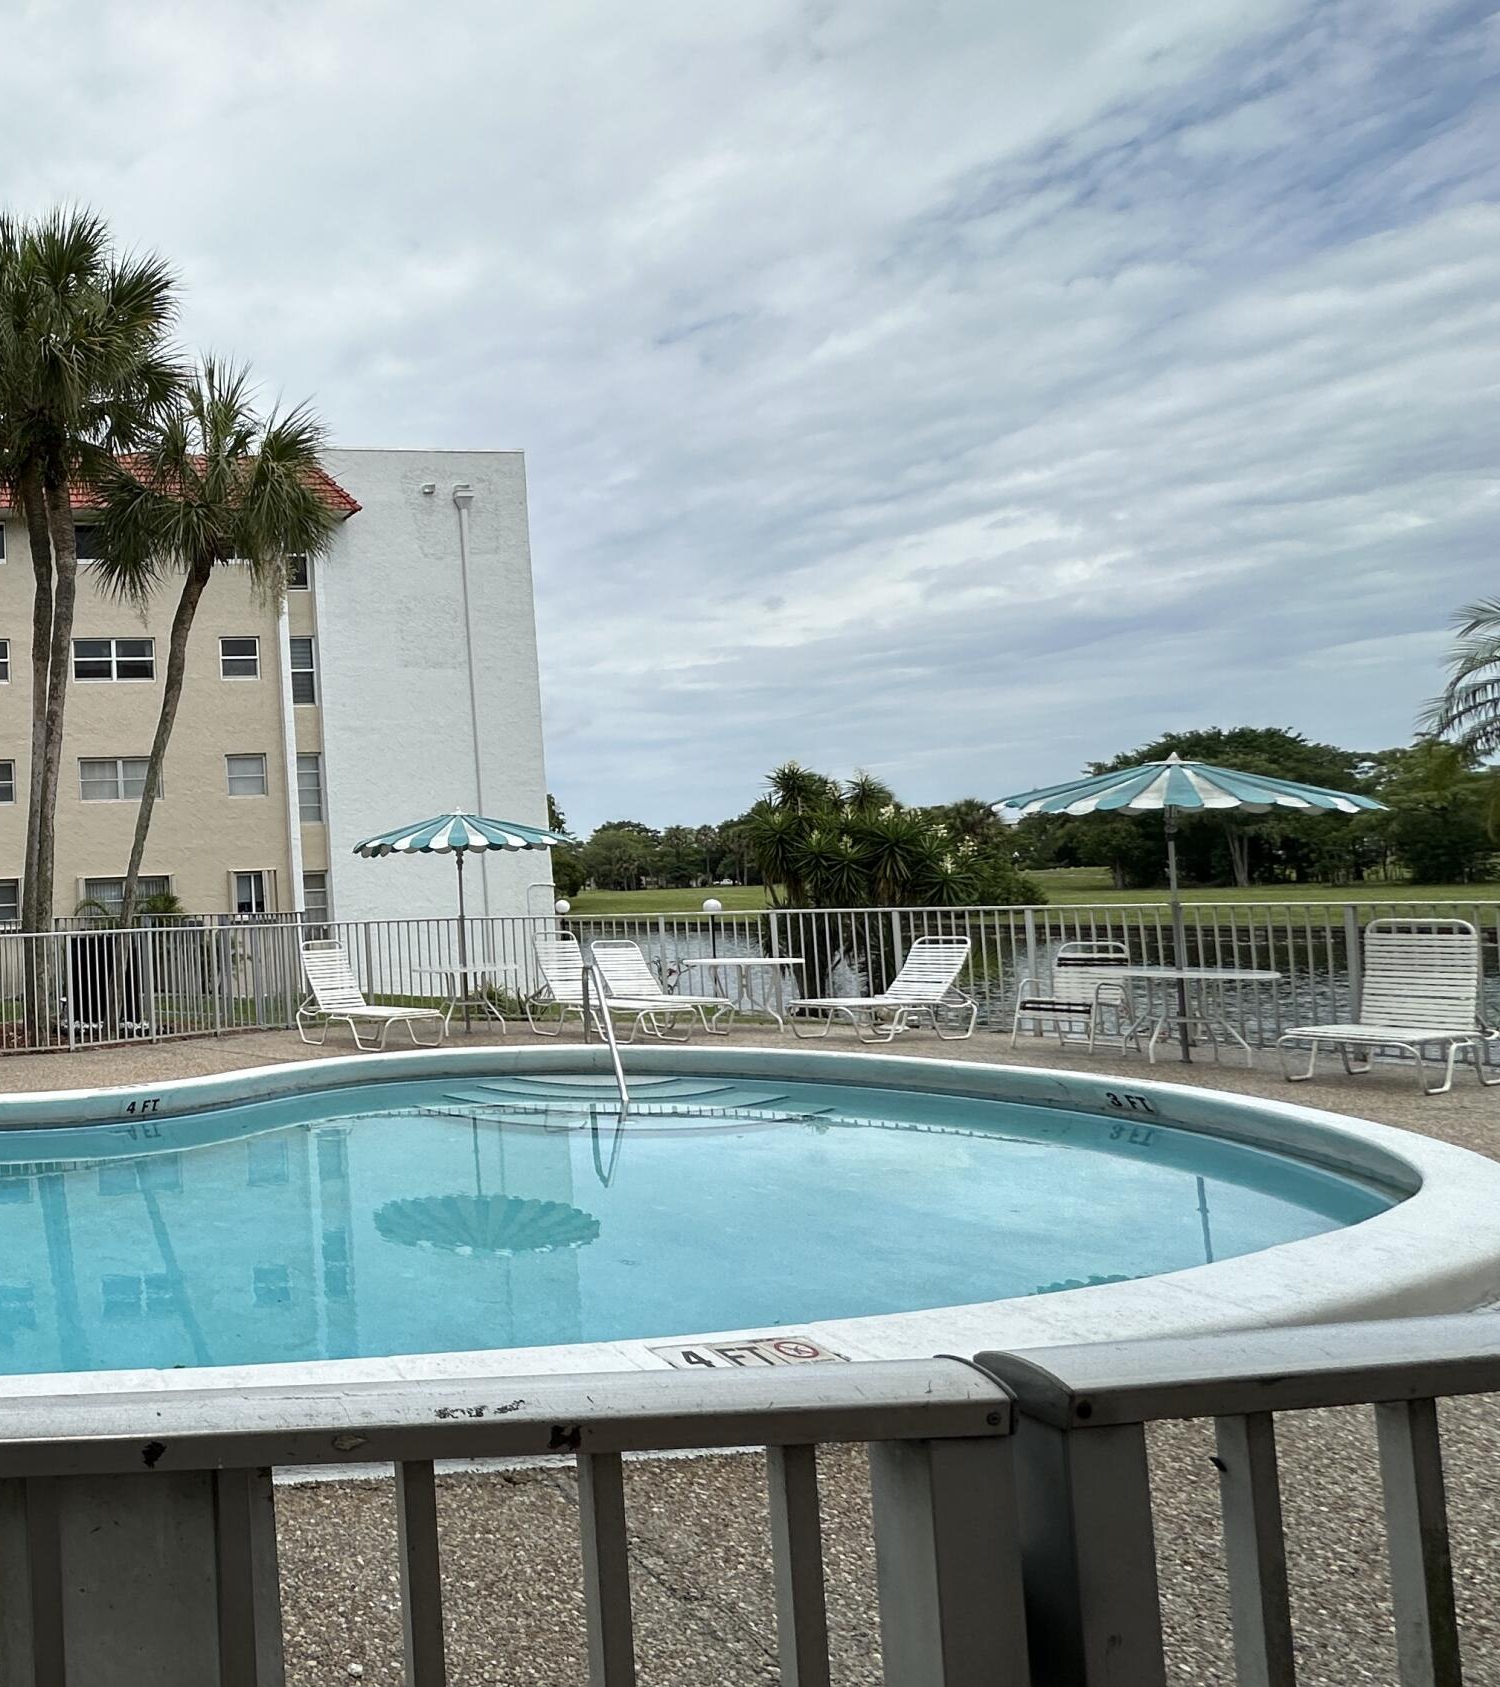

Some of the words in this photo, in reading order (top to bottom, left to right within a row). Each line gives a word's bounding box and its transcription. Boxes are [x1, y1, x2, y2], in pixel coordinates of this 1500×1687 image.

[126, 1101, 137, 1114] 4
[141, 1098, 160, 1113] FT
[1105, 1092, 1123, 1107] 3
[1124, 1094, 1155, 1113] FT
[679, 1350, 717, 1368] 4
[714, 1346, 775, 1367] FT
